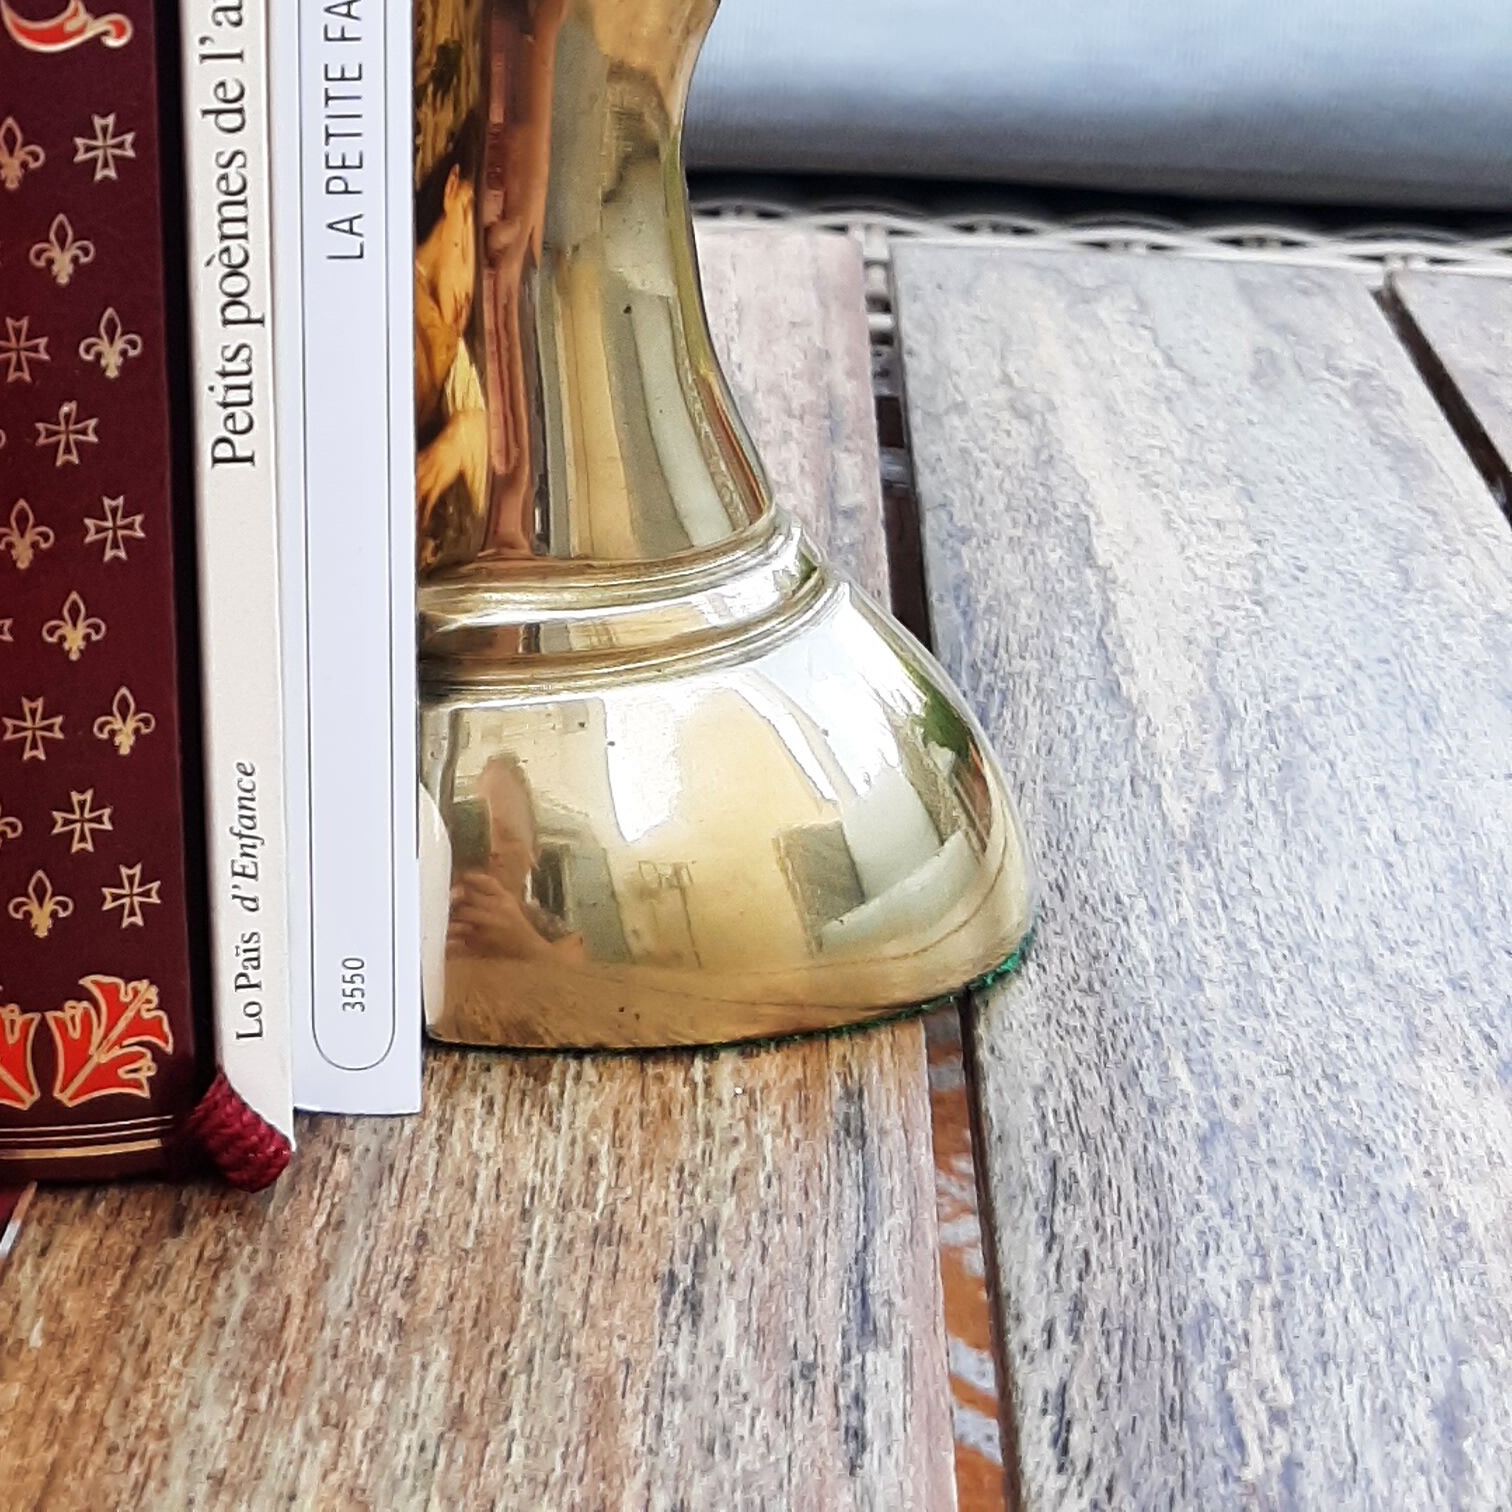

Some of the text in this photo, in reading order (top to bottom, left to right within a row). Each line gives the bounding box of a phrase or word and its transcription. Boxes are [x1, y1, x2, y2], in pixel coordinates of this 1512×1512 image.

[201, 76, 247, 135] de
[324, 61, 364, 196] PETITE
[203, 148, 266, 329] poèmes
[326, 213, 365, 260] LA
[208, 341, 255, 469] Petits
[229, 761, 265, 1042] Lo Païs d'Enfance
[341, 957, 366, 1013] 3550
